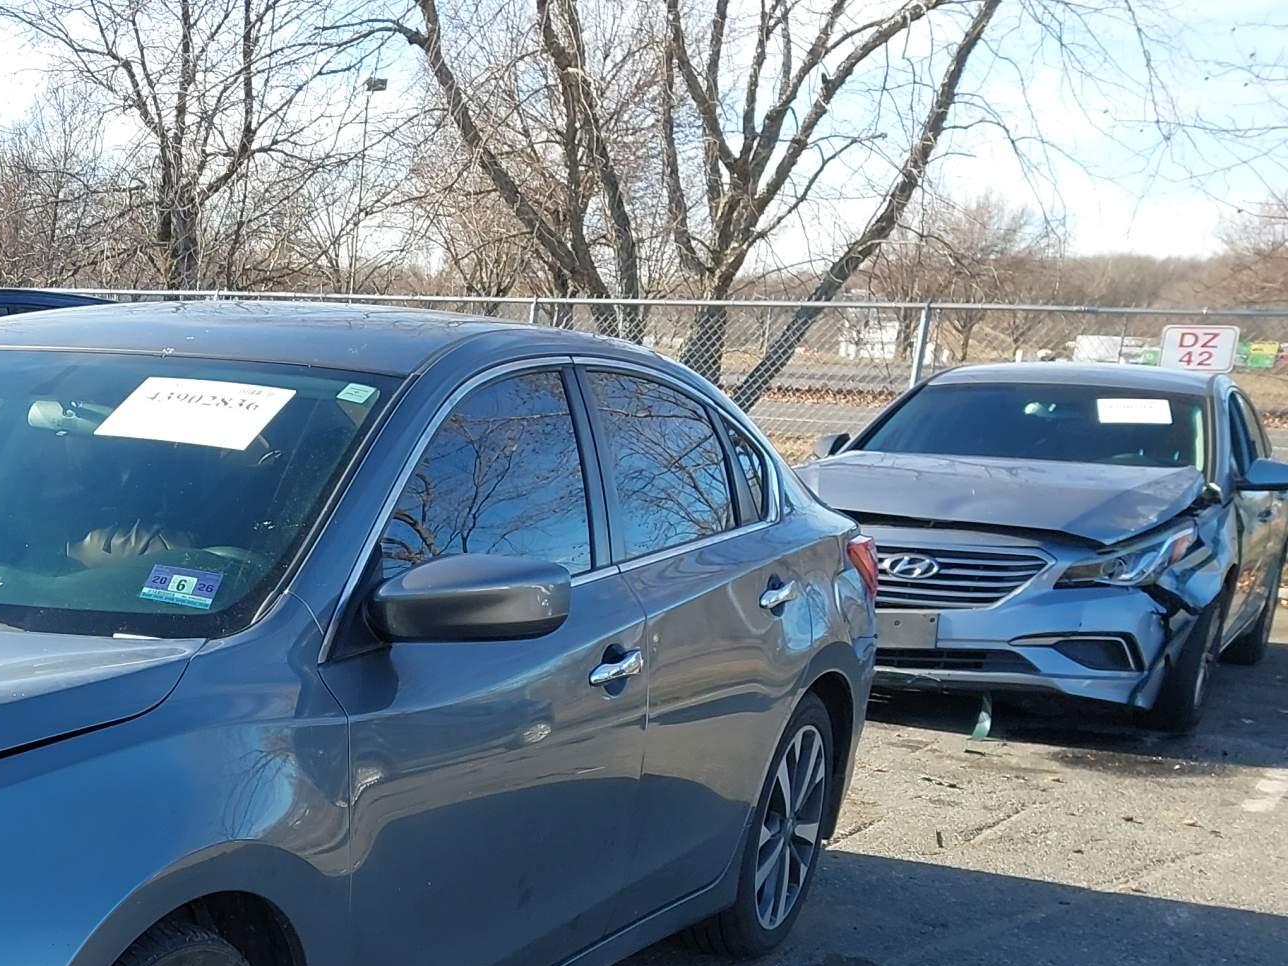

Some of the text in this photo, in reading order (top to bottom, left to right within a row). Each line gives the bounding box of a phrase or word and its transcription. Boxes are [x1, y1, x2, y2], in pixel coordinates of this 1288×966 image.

[1178, 332, 1221, 348] DZ
[1178, 351, 1213, 366] 42
[152, 575, 215, 593] 20 6 26
